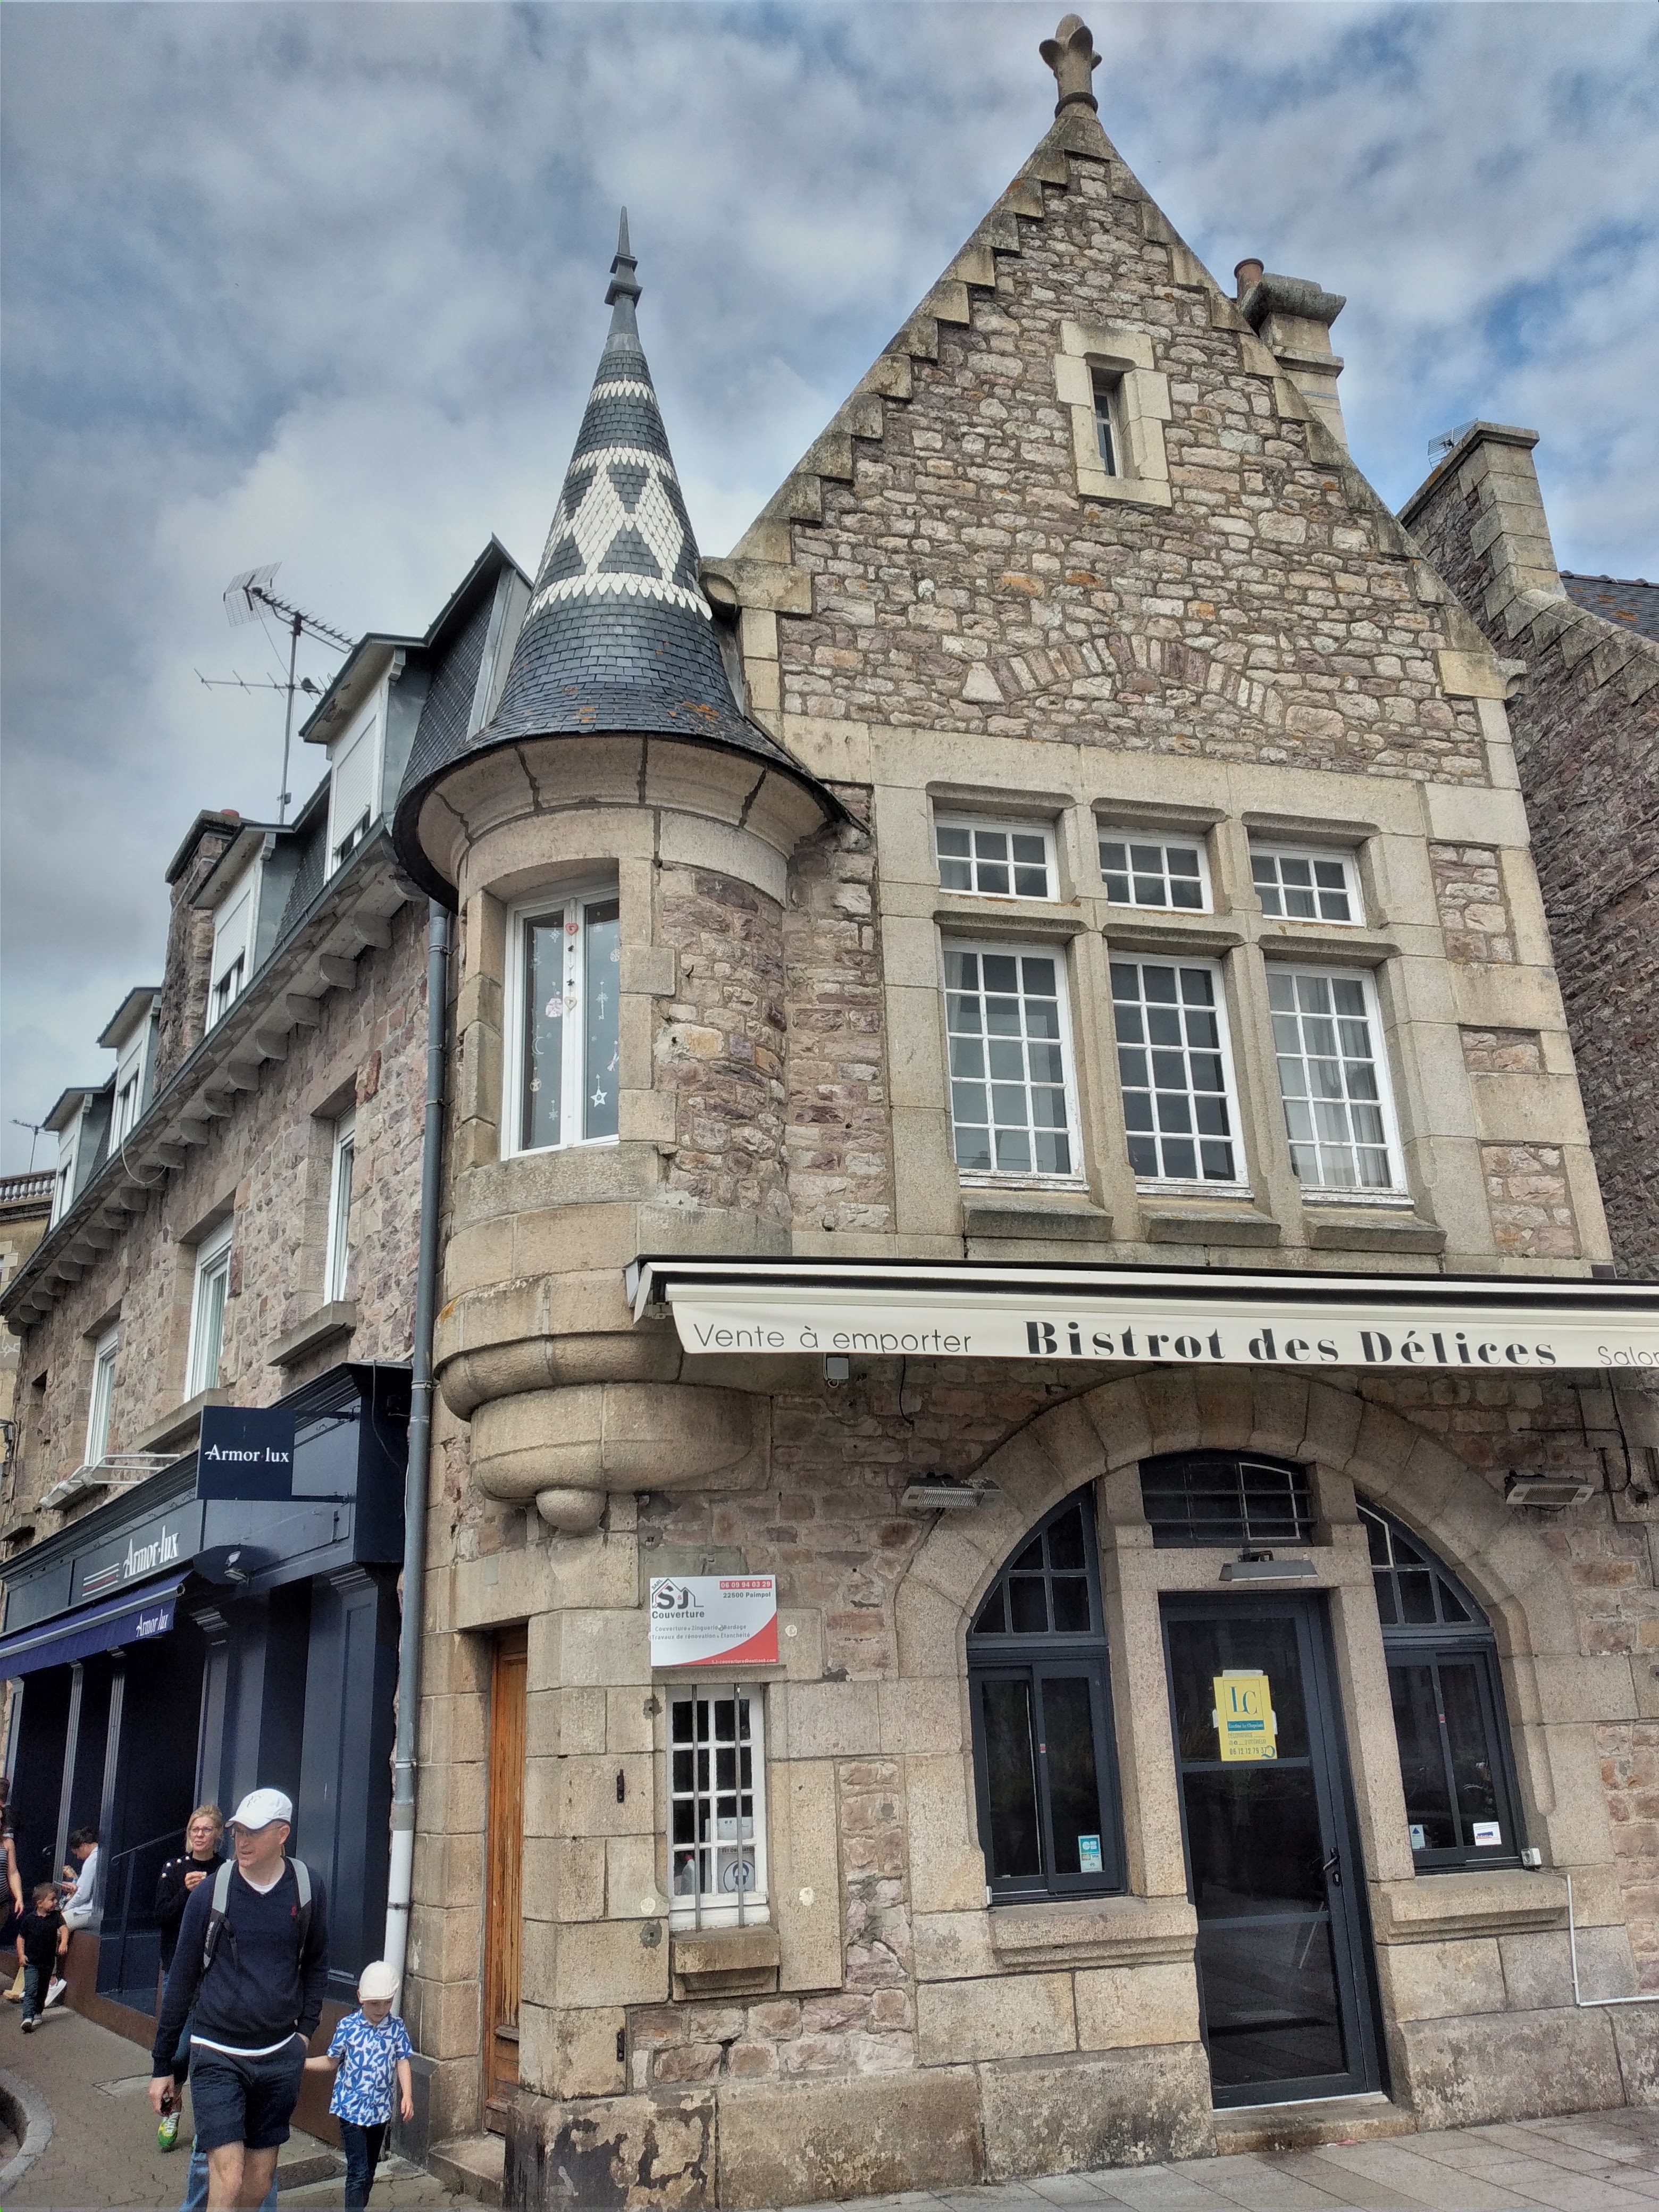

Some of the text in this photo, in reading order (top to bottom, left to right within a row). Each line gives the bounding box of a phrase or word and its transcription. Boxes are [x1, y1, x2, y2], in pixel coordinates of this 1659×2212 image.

[693, 1323, 785, 1347] Vente
[799, 1326, 819, 1348] à
[833, 1329, 972, 1353] emporter
[1023, 1321, 1226, 1359] Bistrot
[1248, 1328, 1339, 1362] des
[1357, 1330, 1556, 1365] Délices
[205, 1444, 290, 1462] Armor lux
[123, 1525, 179, 1579] Armor lux
[651, 1579, 663, 1590] SARL
[136, 1608, 169, 1638] Armor lux
[652, 1610, 705, 1619] Couverture
[1229, 1686, 1258, 1715] LC
[1082, 1840, 1097, 1850] CB
